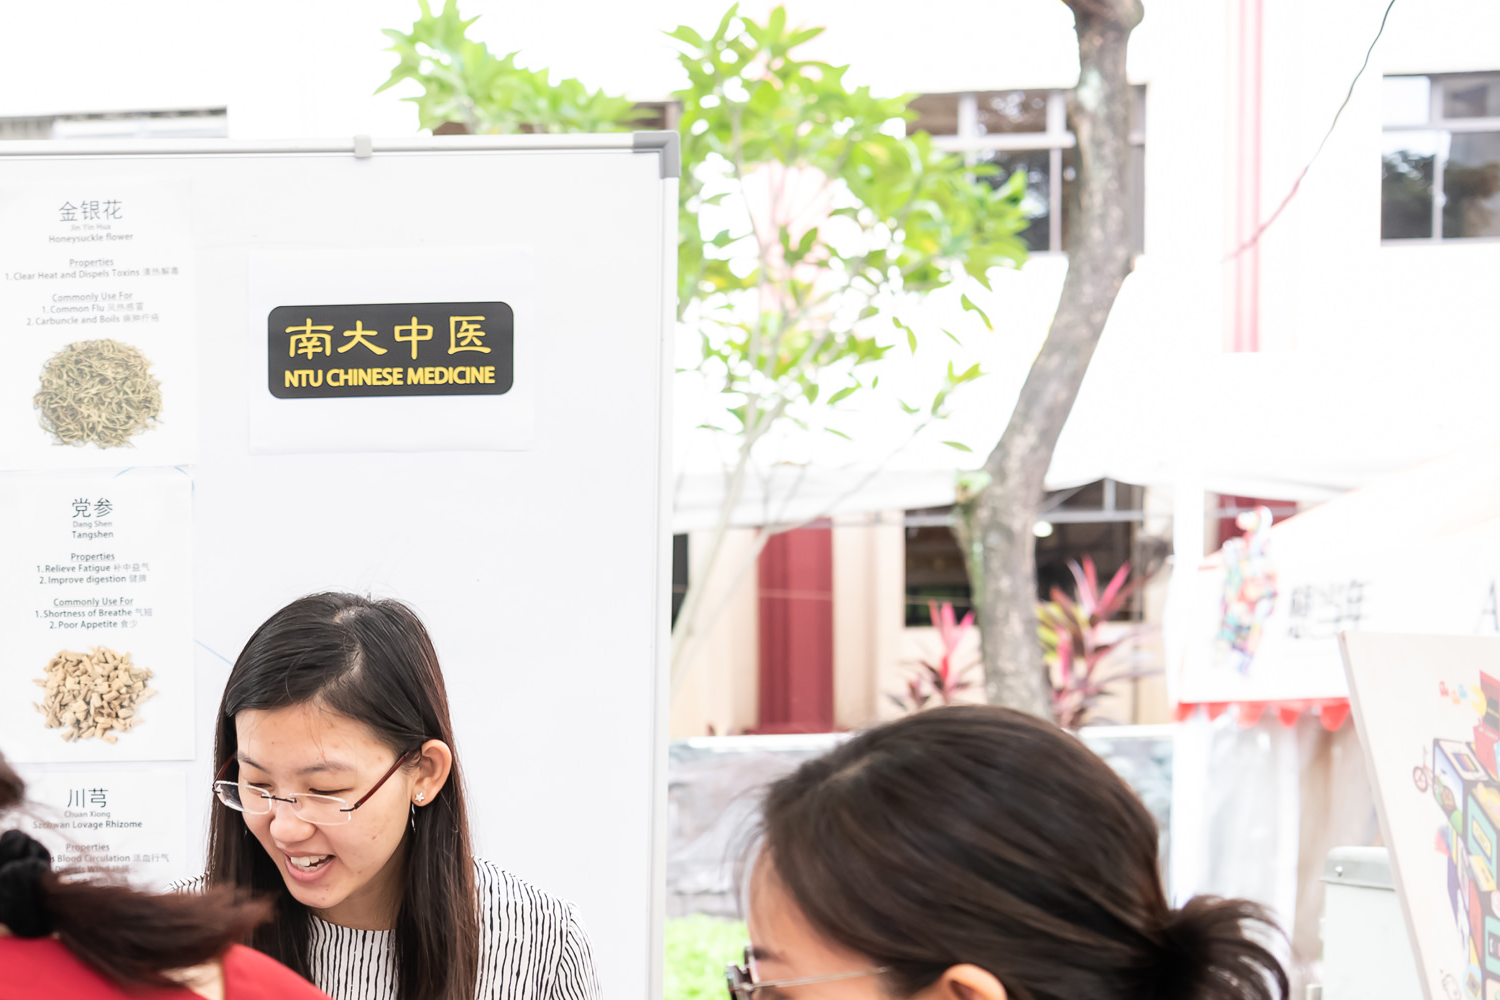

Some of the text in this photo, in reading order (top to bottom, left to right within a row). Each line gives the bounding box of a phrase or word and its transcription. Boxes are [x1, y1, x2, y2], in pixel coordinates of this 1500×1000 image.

[59, 199, 123, 222] 金银花
[49, 233, 133, 244] Honeysuckle flower
[70, 259, 114, 267] Properties
[60, 271, 76, 279] and
[79, 271, 109, 280] Dispels
[112, 269, 139, 277] Toxins
[285, 316, 491, 360] 南大中医
[285, 366, 495, 387] NTU CHINESE MEDICINE
[72, 498, 113, 518] 党参
[72, 531, 113, 540] Tangshen
[71, 553, 115, 562] Properties
[79, 564, 111, 573] Fatigue
[86, 575, 126, 584] digestion
[53, 598, 99, 607] Commonly
[120, 597, 133, 605] For
[81, 620, 117, 629] Appetite
[68, 788, 108, 808] 川芎
[73, 821, 103, 830] Lovage
[66, 844, 110, 852] Properties
